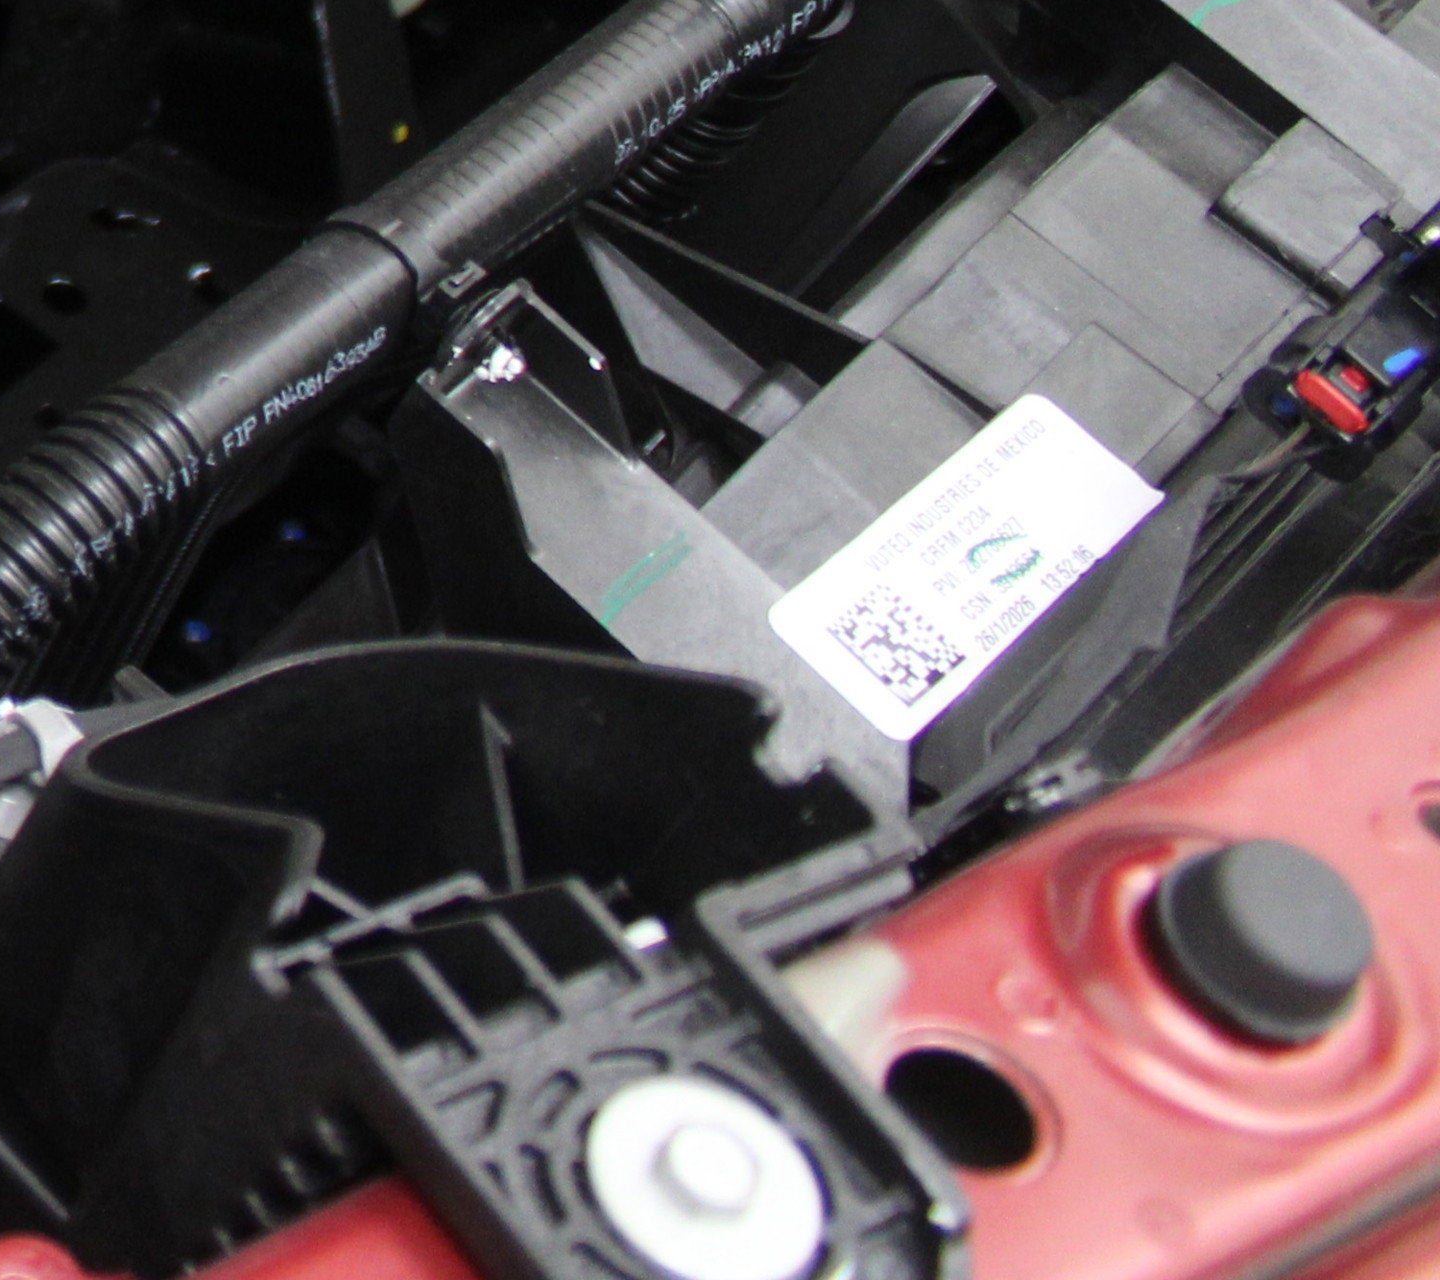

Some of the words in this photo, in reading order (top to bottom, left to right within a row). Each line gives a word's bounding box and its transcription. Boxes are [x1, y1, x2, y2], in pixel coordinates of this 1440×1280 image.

[866, 533, 911, 572] VUTEQ
[907, 473, 981, 536] INDUSTRIES
[978, 458, 998, 475] DE
[996, 419, 1045, 461] MEXICO
[975, 597, 1036, 650] 26/1/2026
